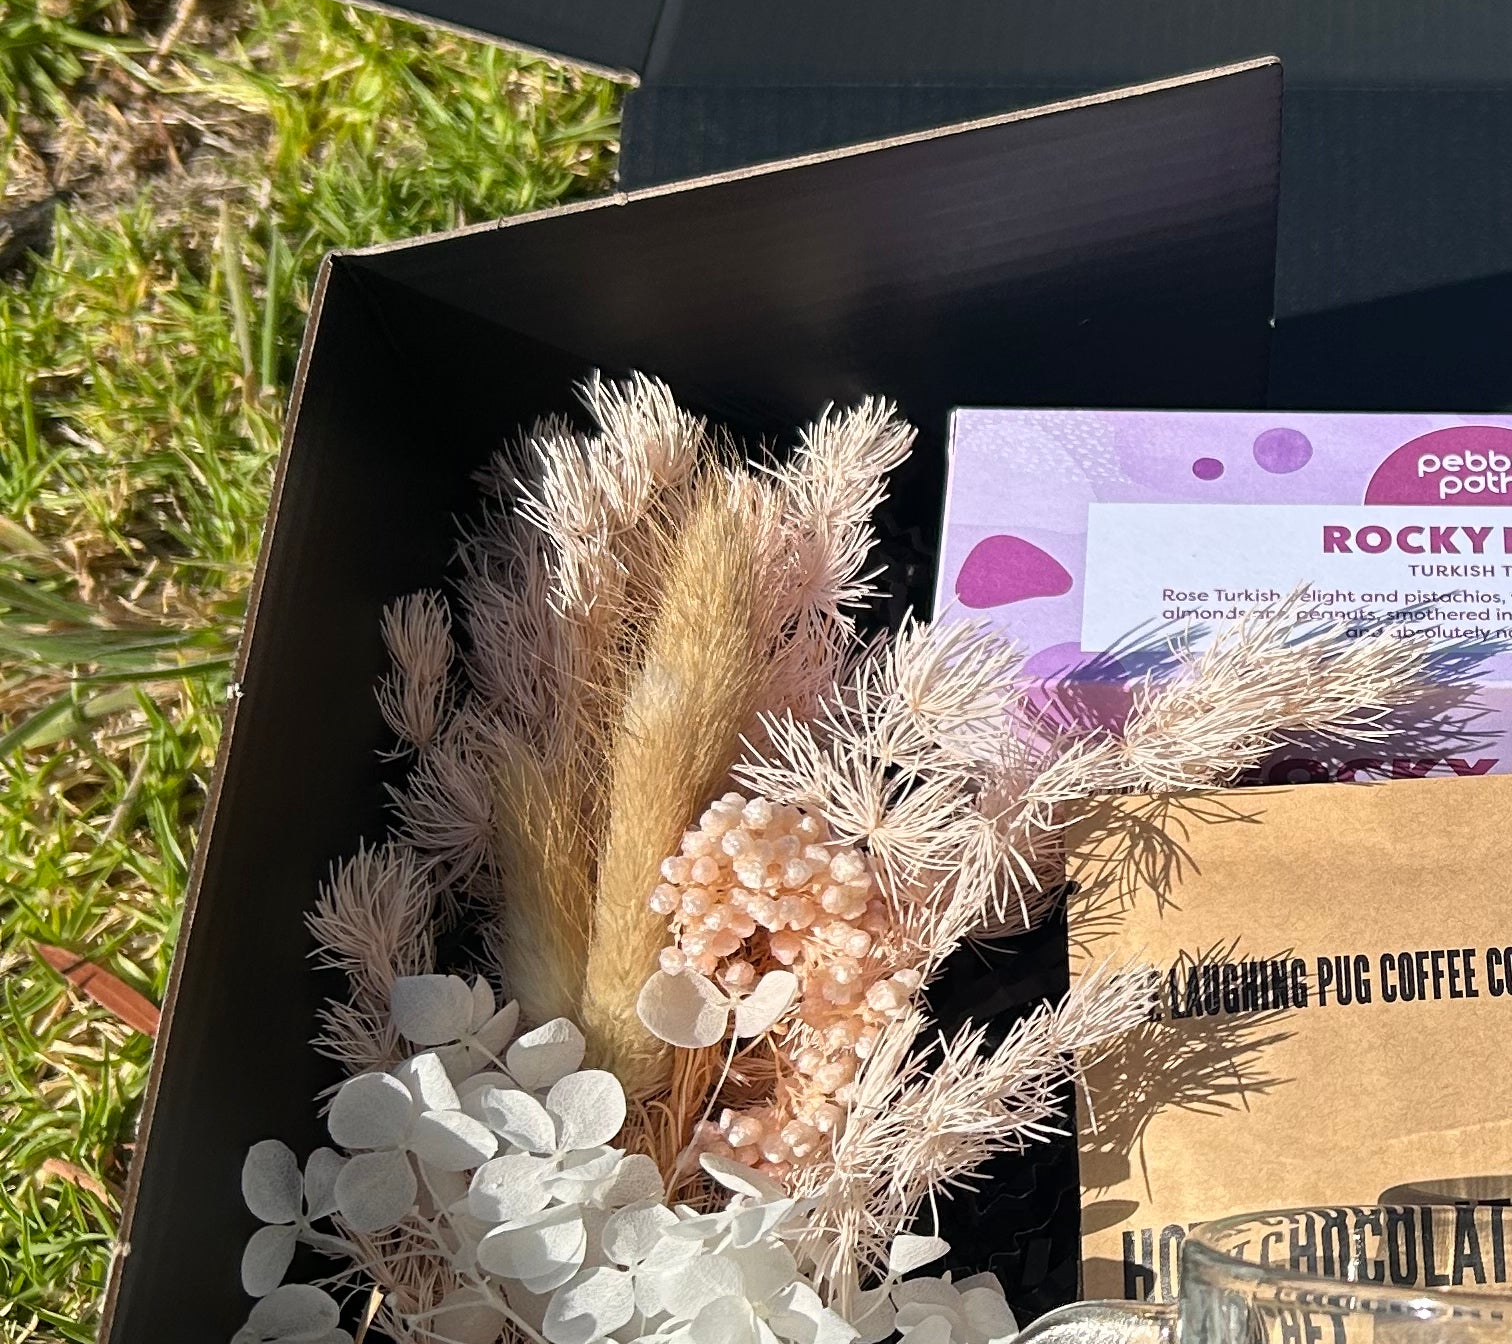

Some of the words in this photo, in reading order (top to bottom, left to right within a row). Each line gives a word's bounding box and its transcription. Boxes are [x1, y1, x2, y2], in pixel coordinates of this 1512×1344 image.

[1322, 525, 1493, 555] ROCKY
[1408, 564, 1495, 577] TURKISH
[1162, 588, 1209, 602] Rose
[1213, 588, 1281, 602] Turkish
[1288, 589, 1355, 606] elight
[1361, 590, 1398, 603] and
[1404, 589, 1506, 605] pistachios,
[1387, 607, 1490, 621] smothered
[1496, 607, 1512, 621] in
[1168, 958, 1308, 1020] LAUGHING
[1317, 953, 1372, 1007] PUG
[1381, 949, 1479, 1003] COFFEE
